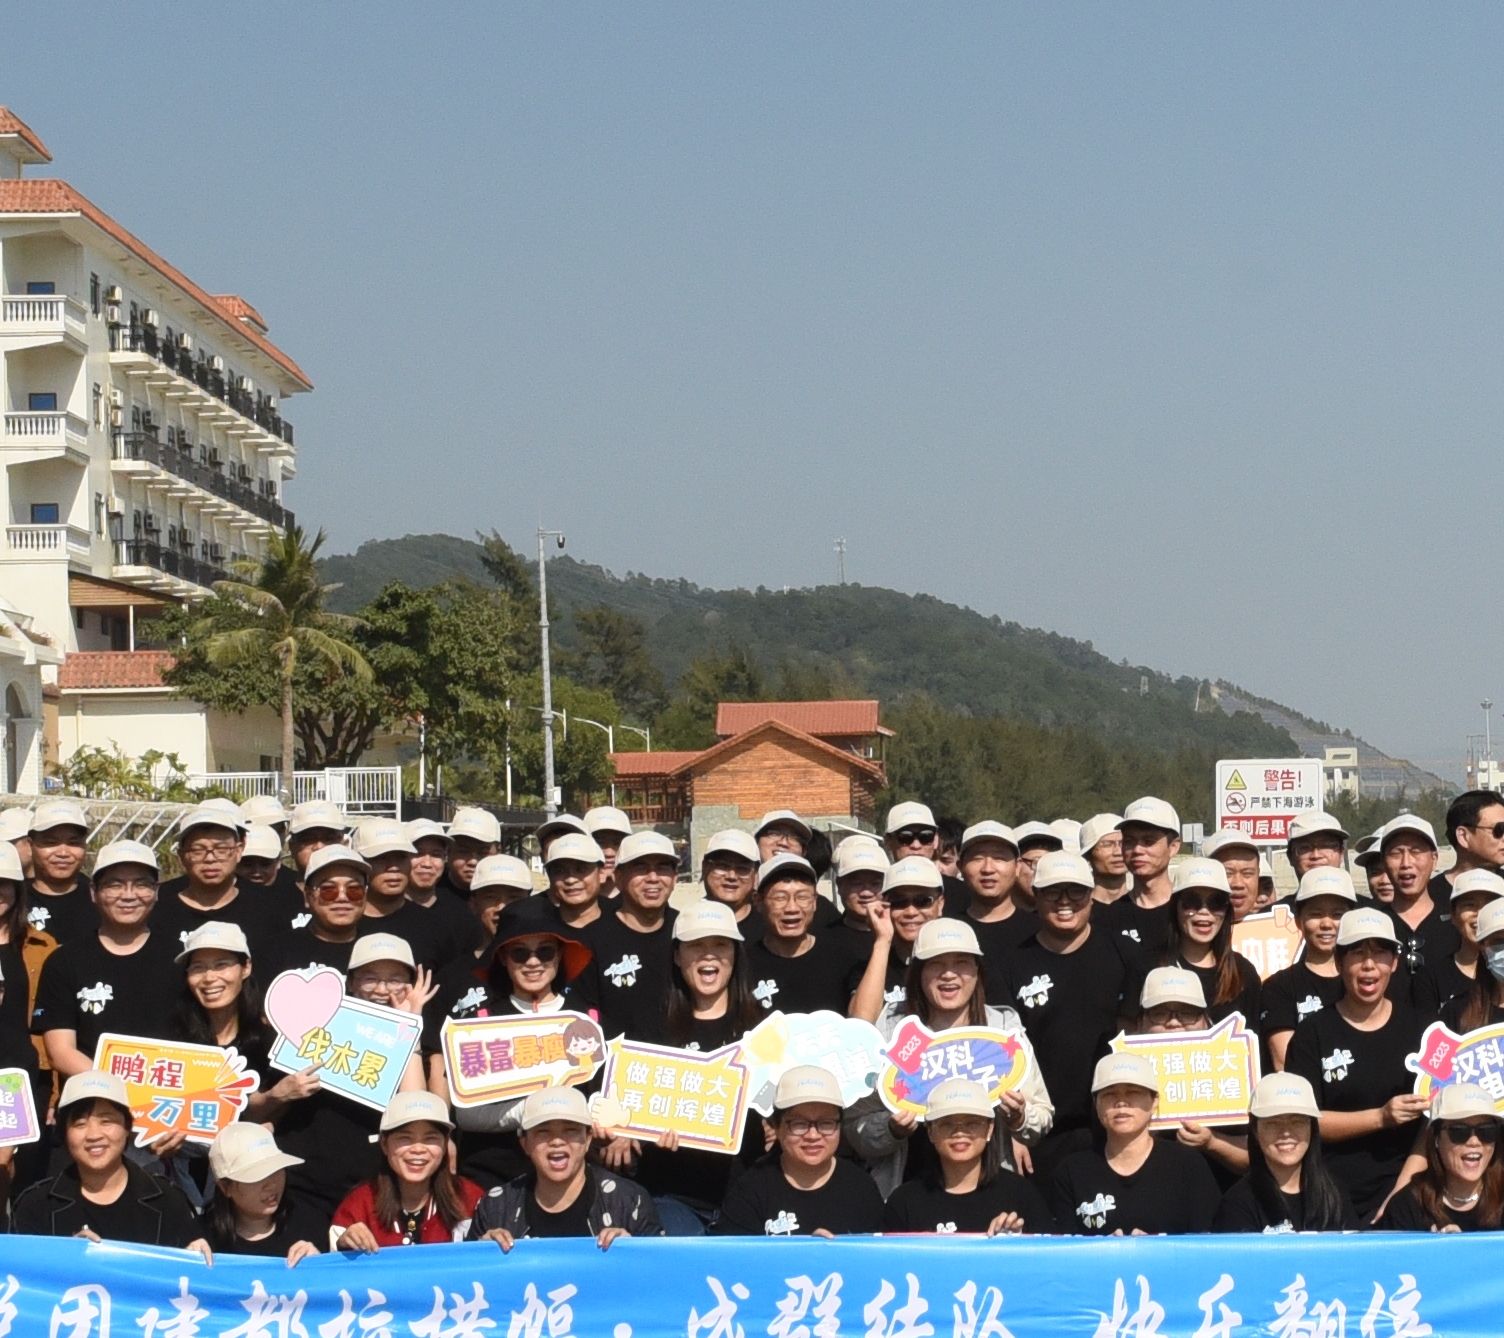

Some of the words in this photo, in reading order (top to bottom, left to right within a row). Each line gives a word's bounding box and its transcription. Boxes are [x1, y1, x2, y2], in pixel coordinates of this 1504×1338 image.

[1232, 937, 1290, 976] 内耗
[110, 1053, 185, 1091] 鹏程
[297, 1026, 388, 1091] 伐木累
[459, 1032, 568, 1079] 暴富暴瘦
[919, 1040, 975, 1082] 汉科
[1428, 1041, 1451, 1069] 2023
[1450, 1039, 1504, 1085] 汉科
[625, 1060, 732, 1100] 做强做大
[147, 1095, 220, 1132] 万里
[620, 1090, 726, 1127] 再创辉煌
